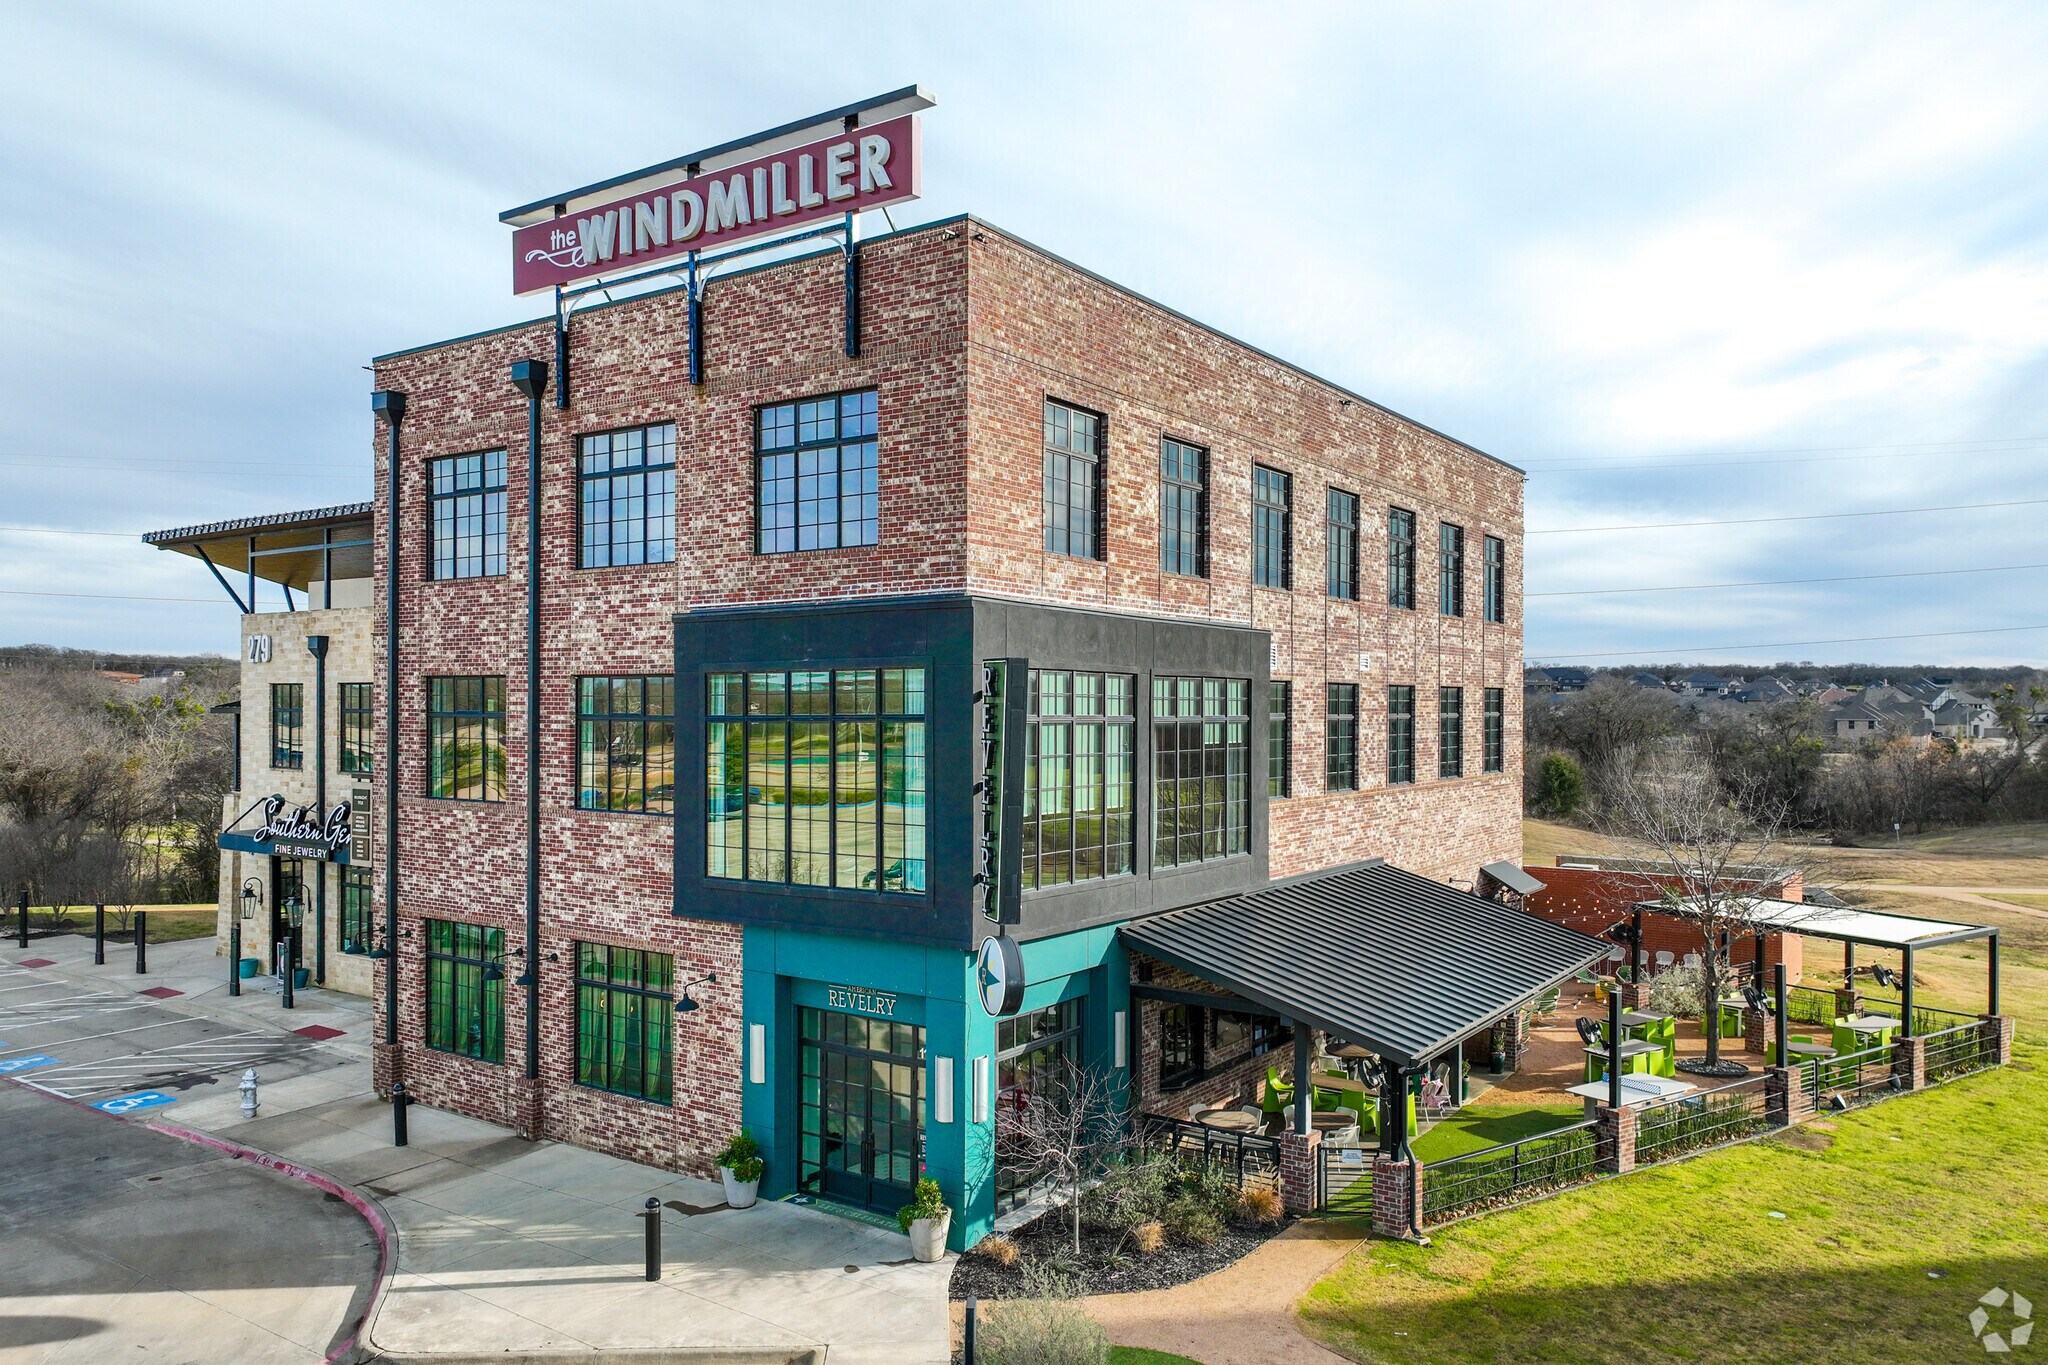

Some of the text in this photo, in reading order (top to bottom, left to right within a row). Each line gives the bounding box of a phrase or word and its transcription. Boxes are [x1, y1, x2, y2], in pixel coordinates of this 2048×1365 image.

[551, 134, 893, 266] the WINDMILLER
[247, 634, 272, 663] 279
[980, 667, 994, 913] REVELRY
[253, 797, 323, 842] Southern
[275, 844, 327, 859] FINE JEWELRY
[828, 989, 897, 1016] REVELRY
[847, 986, 877, 995] AMERICAN
